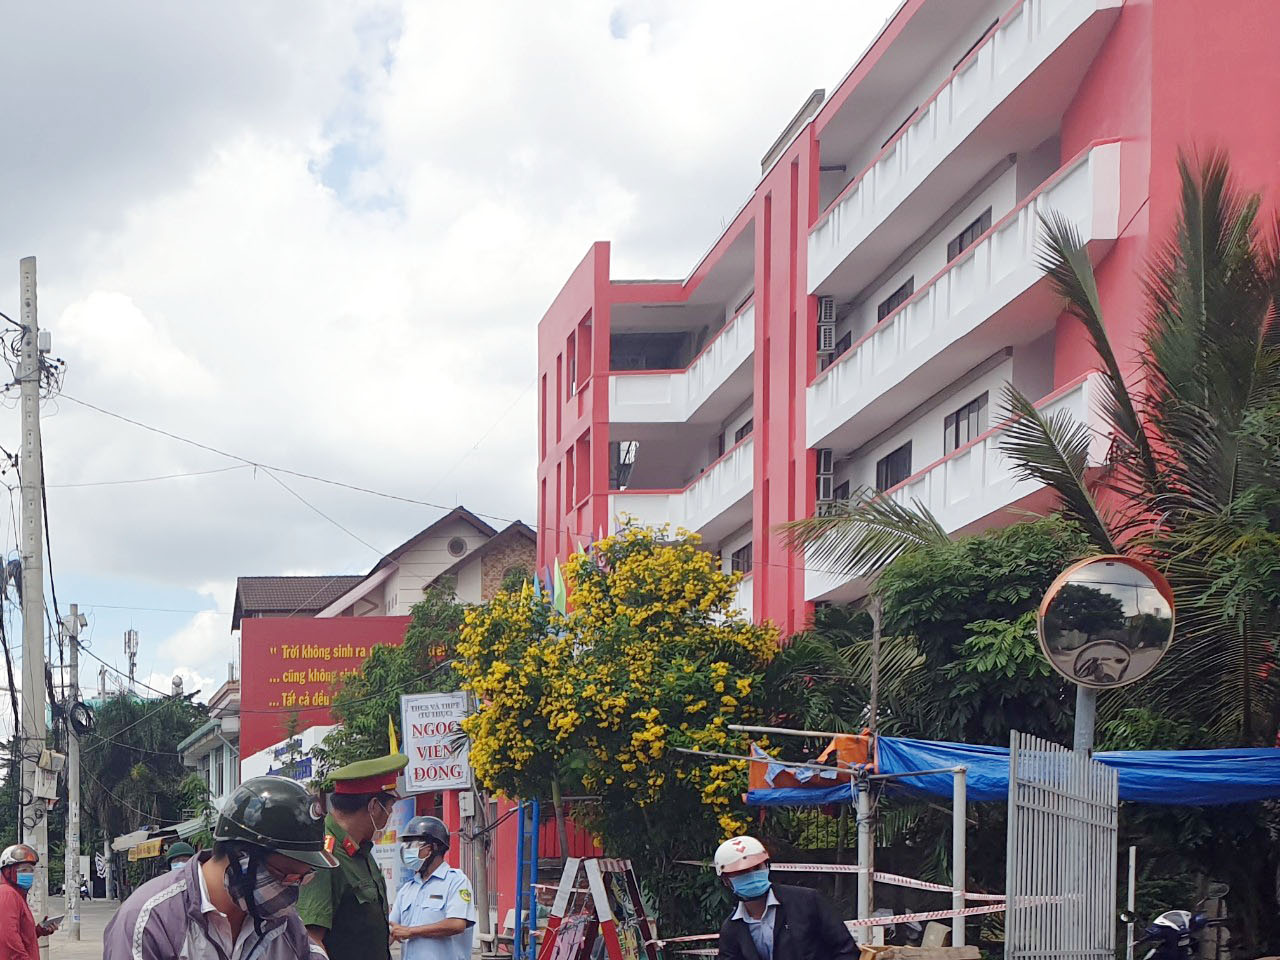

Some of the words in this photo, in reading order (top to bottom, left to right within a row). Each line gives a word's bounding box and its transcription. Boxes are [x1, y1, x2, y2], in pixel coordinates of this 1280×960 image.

[282, 644, 299, 659] Trời
[302, 644, 330, 660] không
[333, 643, 353, 658] sinh
[355, 646, 366, 658] ra
[282, 669, 306, 685] cũng
[308, 668, 336, 684] không
[281, 689, 296, 707] Tất
[298, 690, 310, 706] cả
[312, 689, 330, 706] đều
[411, 704, 430, 713] THCS
[412, 720, 459, 738] NGỌC
[413, 763, 462, 781] ĐÔNG
